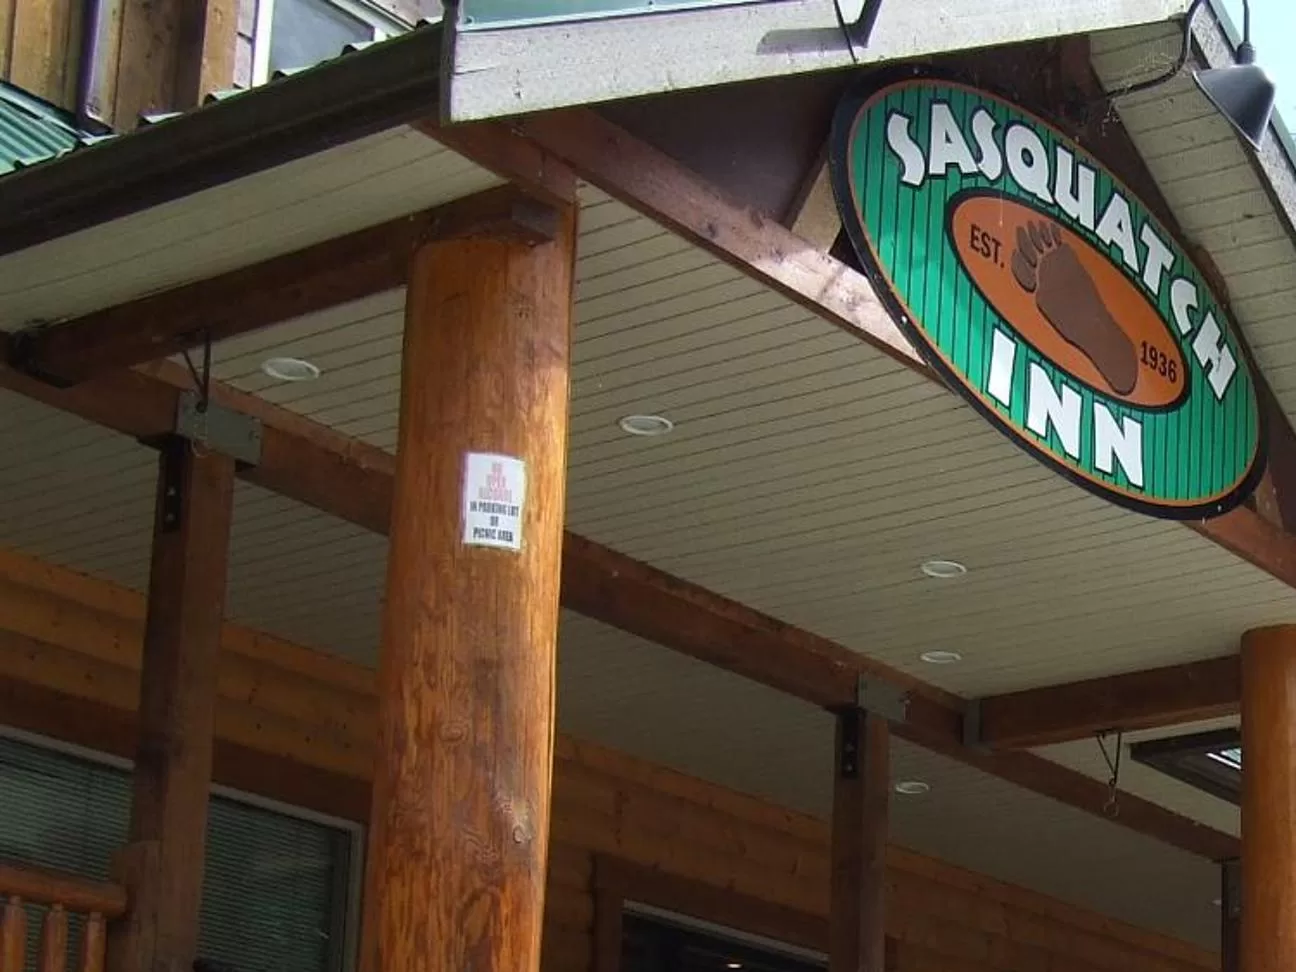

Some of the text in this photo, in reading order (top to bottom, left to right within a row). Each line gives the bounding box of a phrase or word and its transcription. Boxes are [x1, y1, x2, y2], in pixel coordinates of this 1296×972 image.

[886, 103, 1239, 400] SASQUATCH
[969, 224, 1178, 384] EST. 1936
[987, 328, 1143, 488] INN
